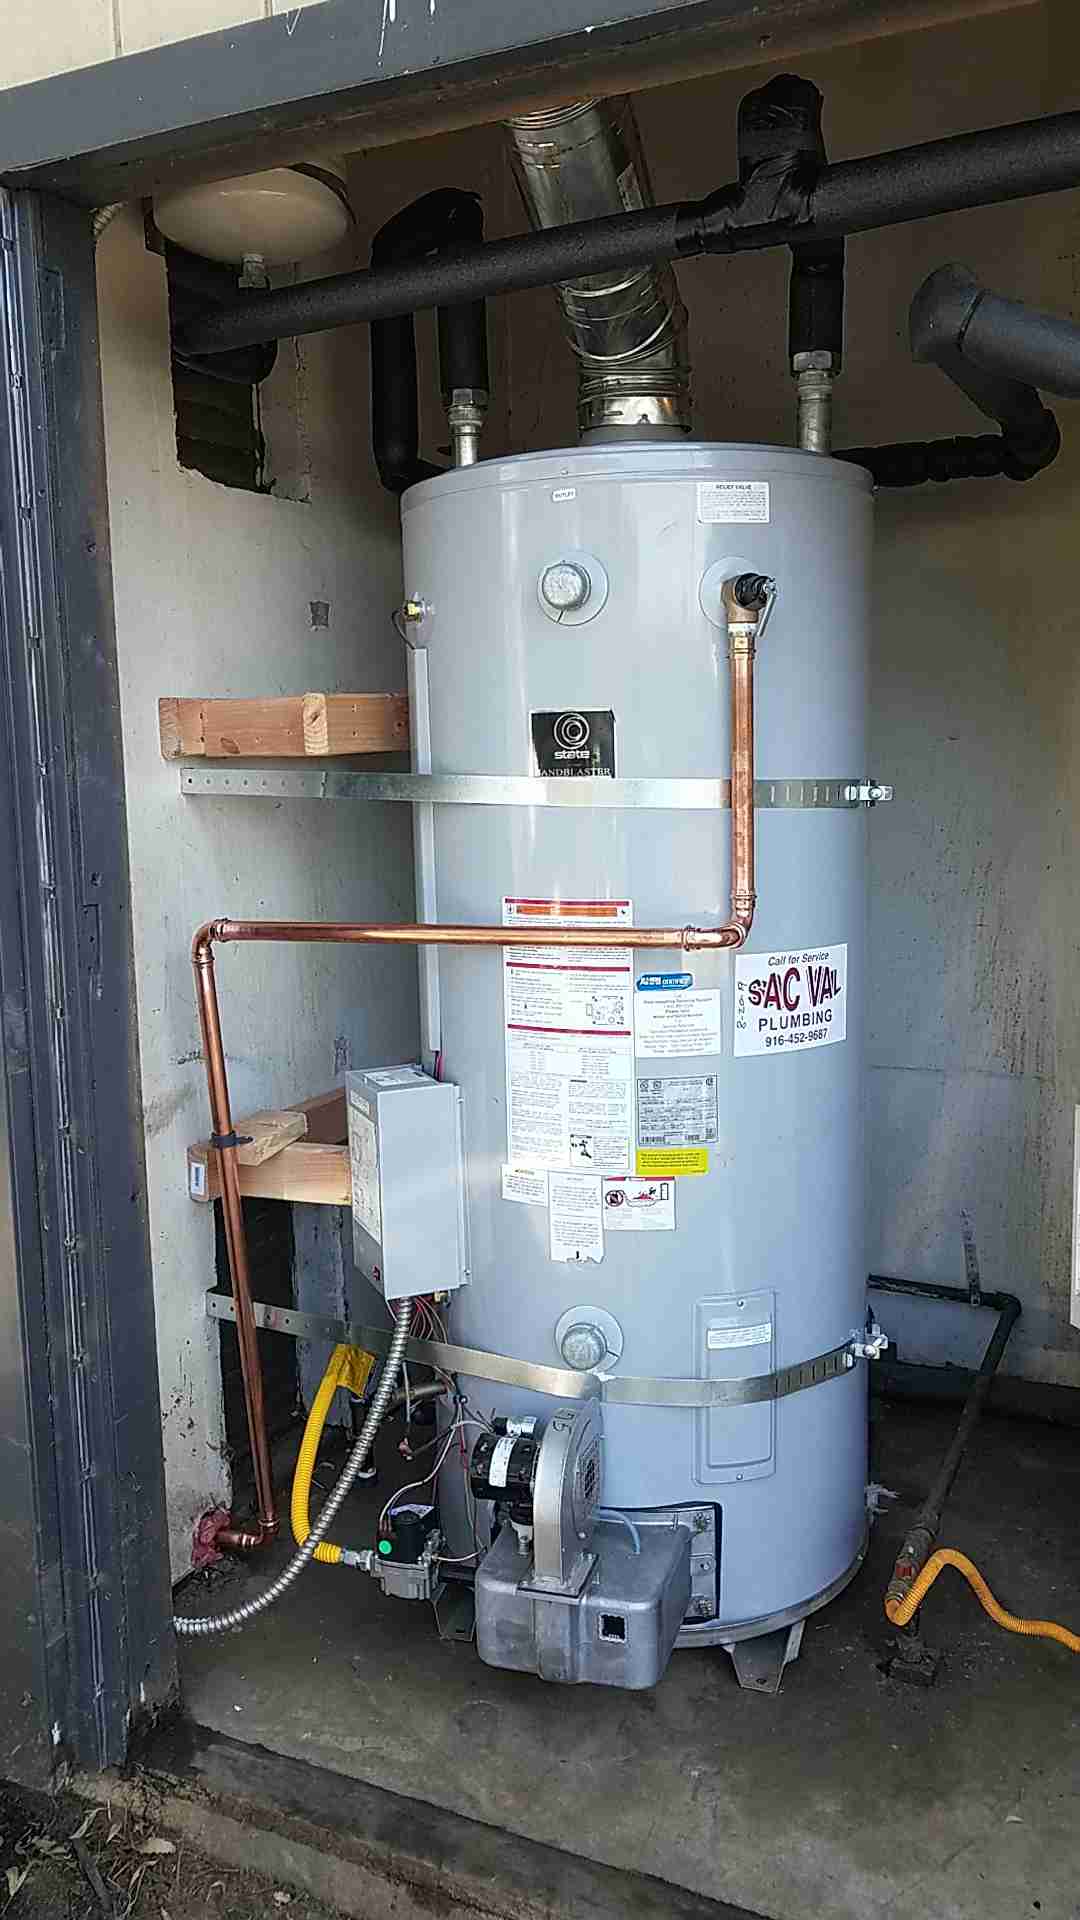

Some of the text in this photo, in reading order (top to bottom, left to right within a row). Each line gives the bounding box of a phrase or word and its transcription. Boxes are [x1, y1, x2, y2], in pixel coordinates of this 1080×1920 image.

[555, 750, 590, 760] state
[538, 768, 610, 777] ANDBLASTER
[768, 951, 830, 966] Call for Service
[748, 965, 841, 1011] SAC VAL
[759, 1009, 832, 1032] PLUMBING
